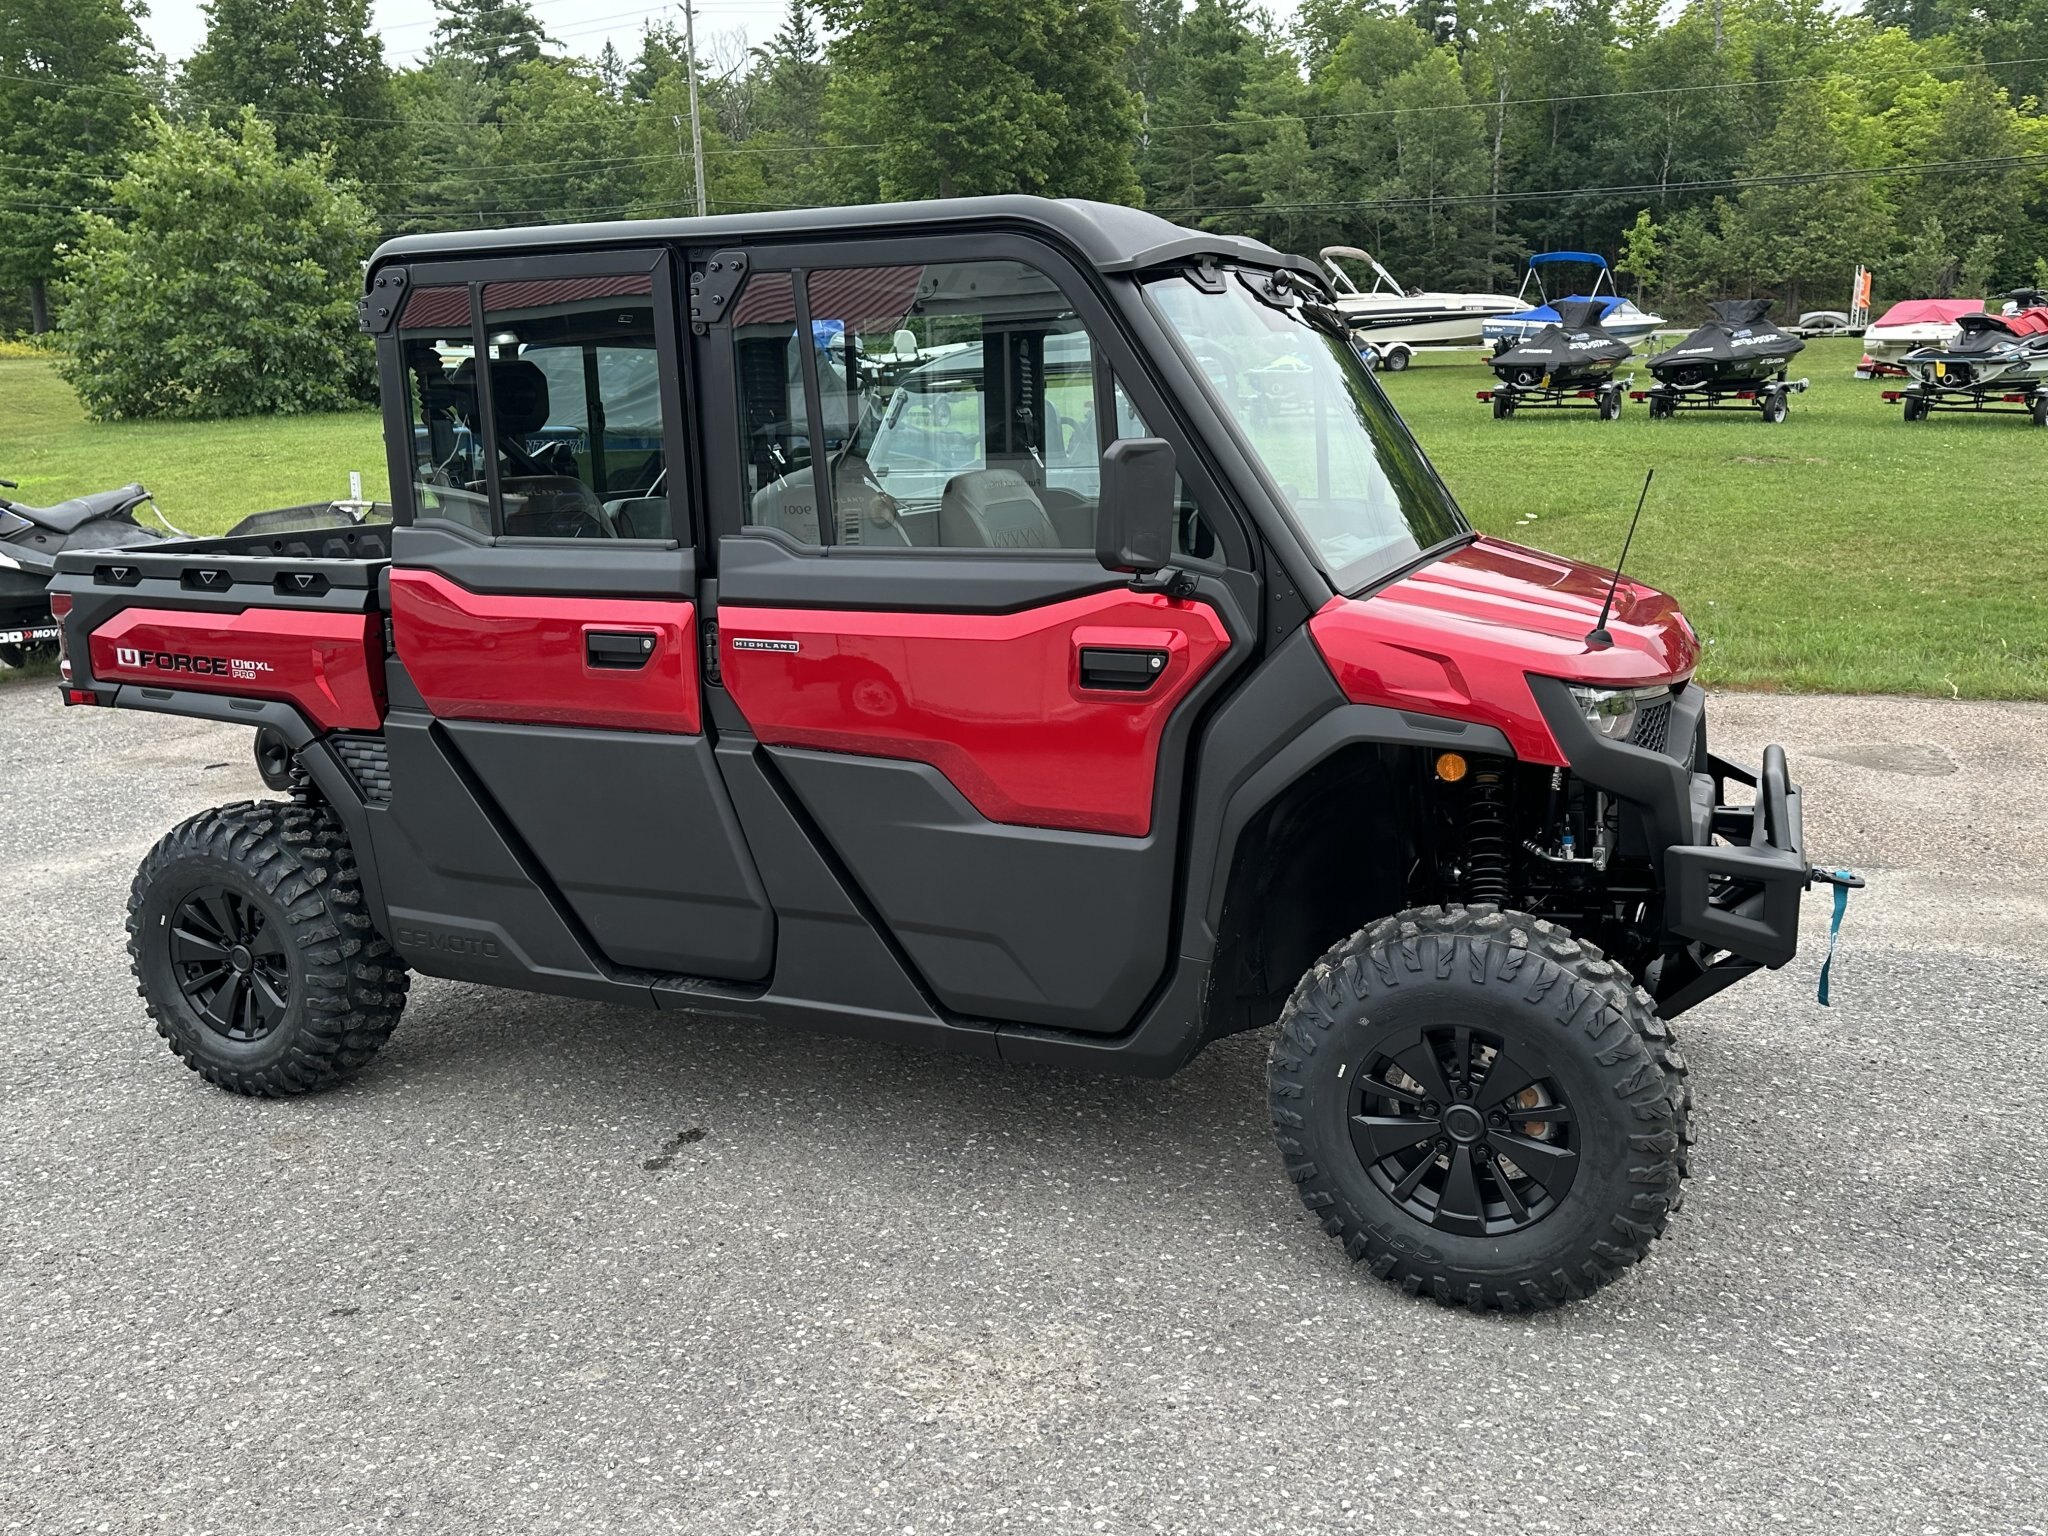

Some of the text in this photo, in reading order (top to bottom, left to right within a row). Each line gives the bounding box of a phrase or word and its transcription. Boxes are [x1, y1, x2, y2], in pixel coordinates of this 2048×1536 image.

[32, 628, 62, 639] MOV
[735, 641, 796, 650] HIGHLAND
[232, 670, 256, 680] PRO
[398, 928, 499, 959] CFMOTO
